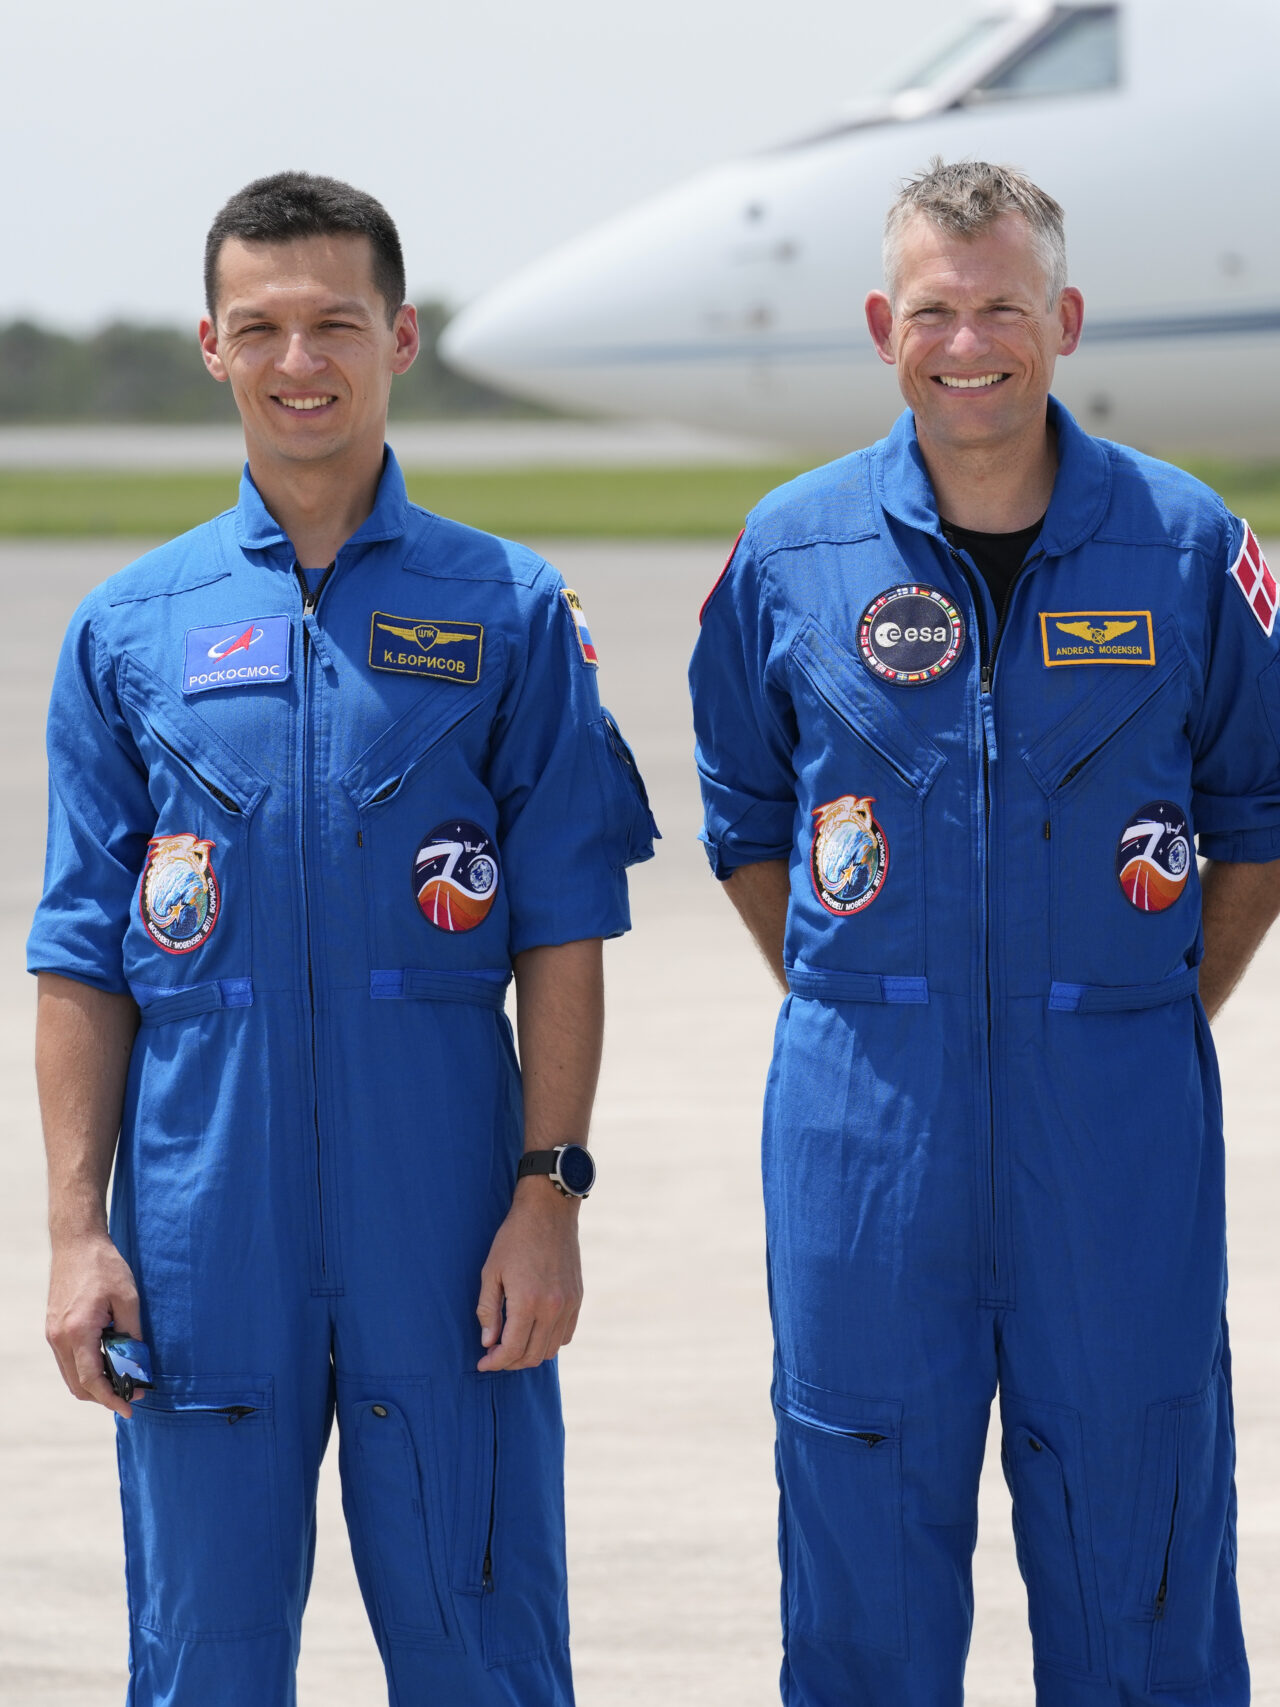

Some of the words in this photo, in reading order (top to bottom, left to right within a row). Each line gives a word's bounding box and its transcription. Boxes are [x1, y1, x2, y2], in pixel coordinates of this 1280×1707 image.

[1056, 645, 1095, 656] ANDREAS
[1099, 645, 1143, 656] MOGENSEN
[189, 664, 281, 687] РОСКОСМОС
